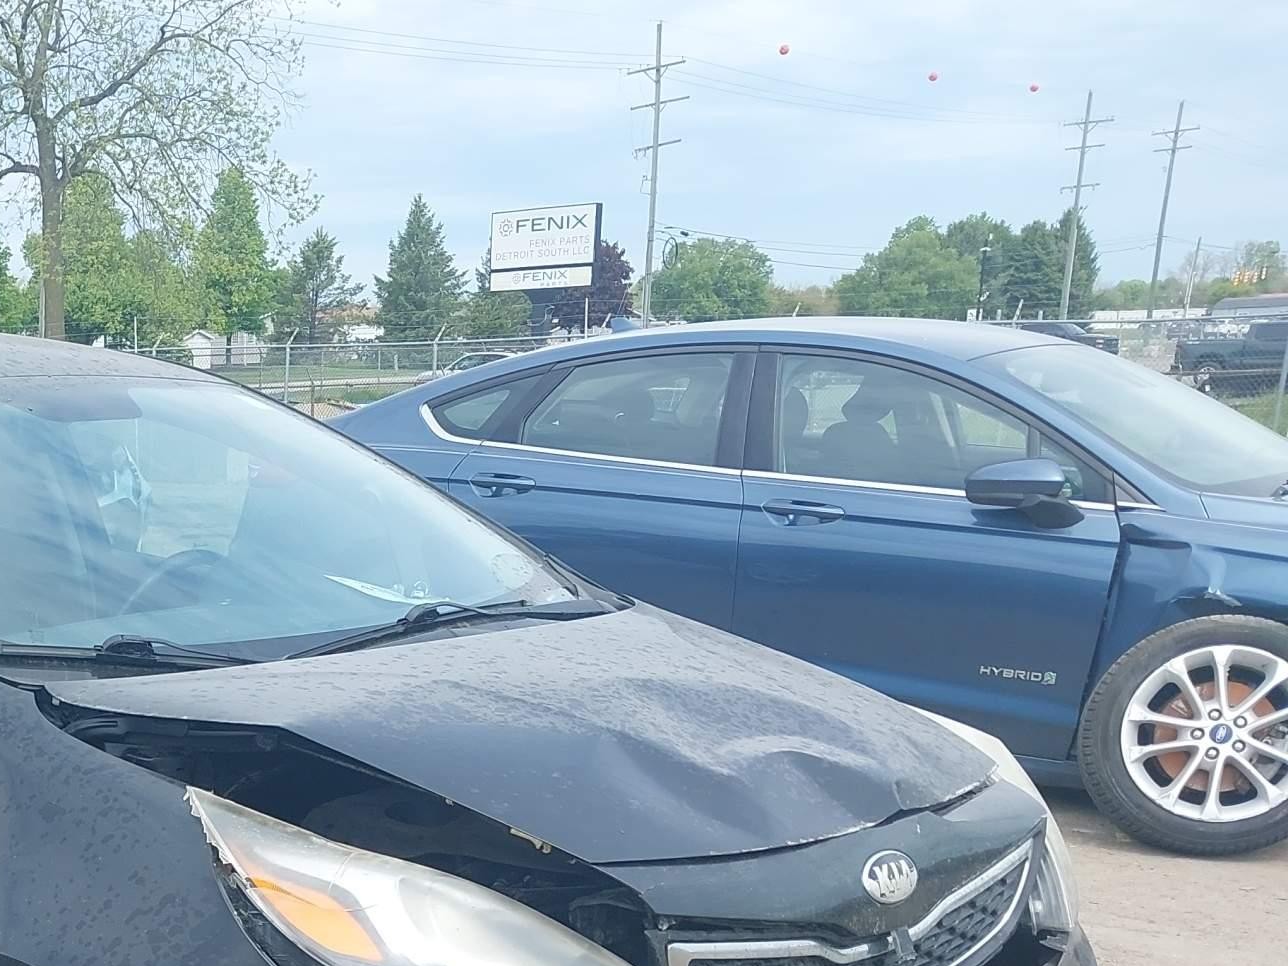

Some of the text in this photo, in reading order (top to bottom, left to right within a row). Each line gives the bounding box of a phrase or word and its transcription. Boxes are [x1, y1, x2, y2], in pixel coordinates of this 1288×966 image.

[515, 213, 588, 234] FENIX
[559, 235, 590, 246] PARTS
[495, 245, 590, 261] DETROIT SOUTH LLC
[522, 269, 568, 282] FENIX
[979, 665, 1043, 682] HYBRID
